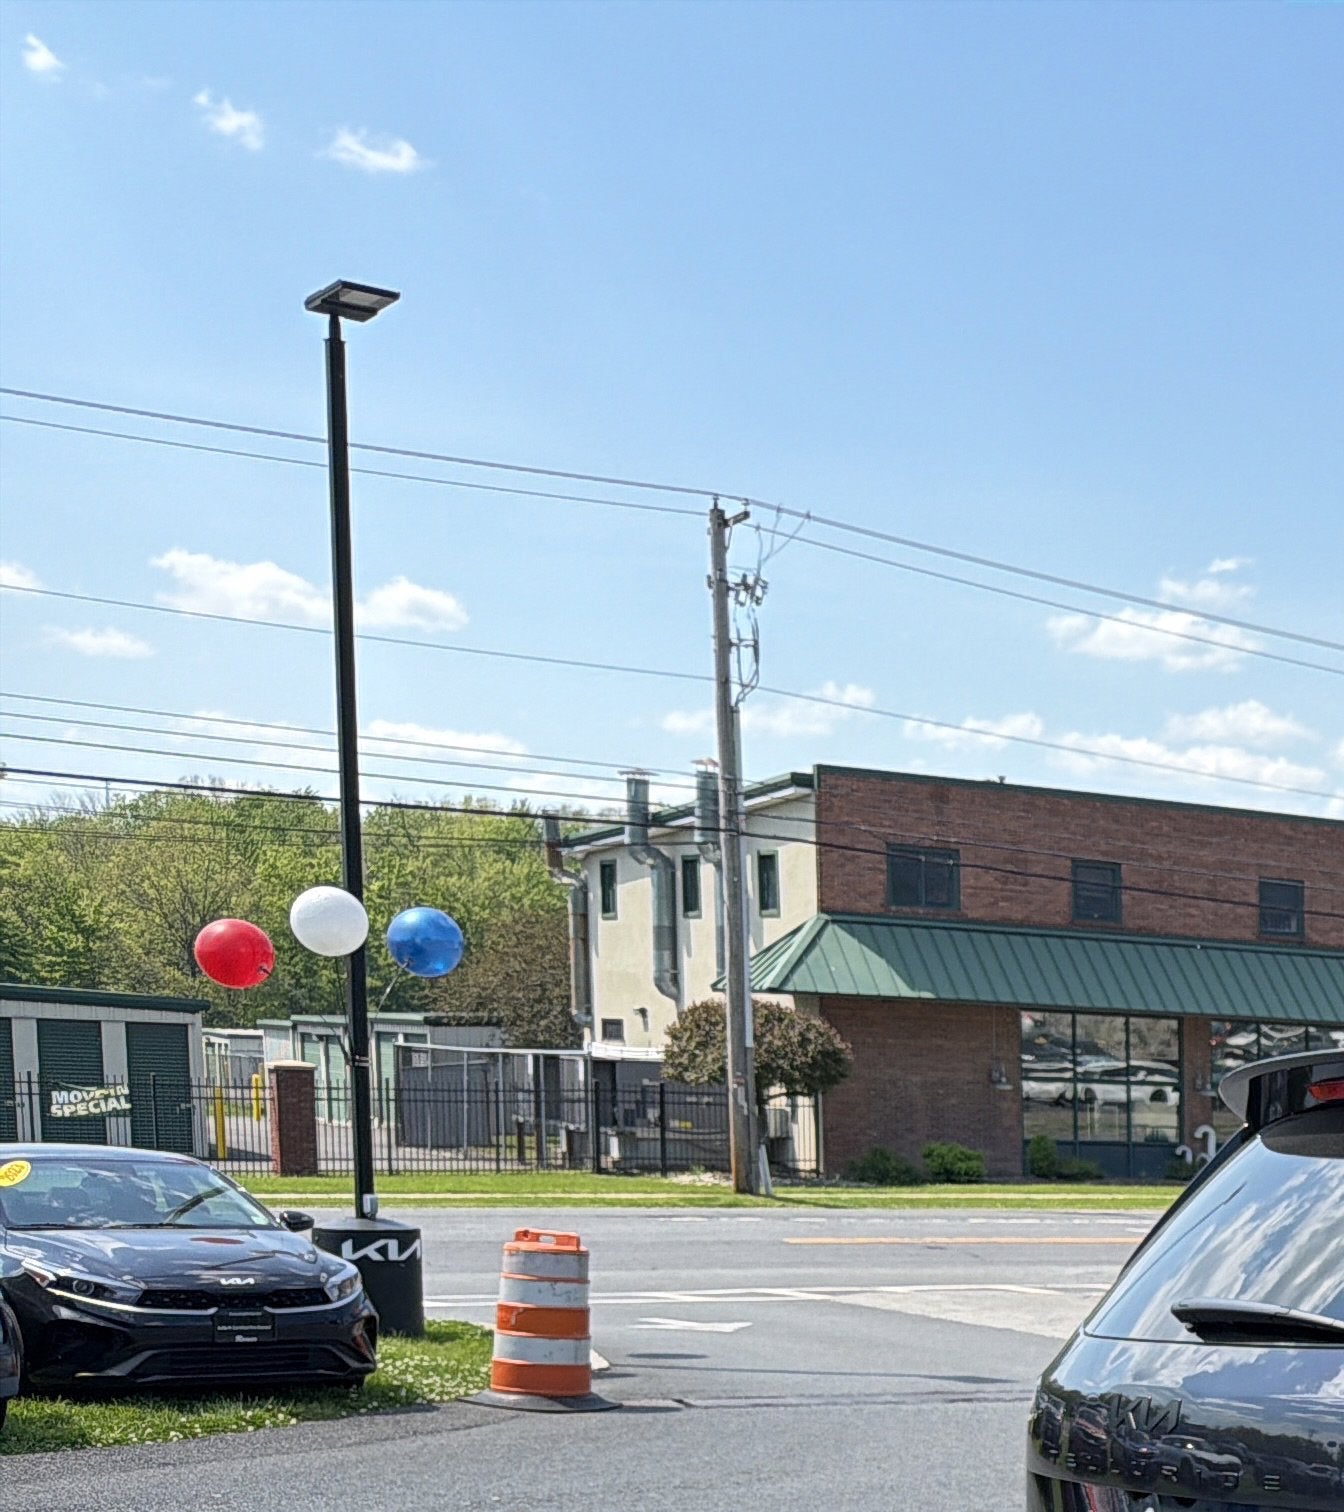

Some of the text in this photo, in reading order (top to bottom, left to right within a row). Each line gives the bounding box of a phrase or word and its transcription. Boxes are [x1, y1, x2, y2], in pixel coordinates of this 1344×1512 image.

[50, 1096, 132, 1117] SPECIAL
[341, 1238, 421, 1261] KIA
[220, 1277, 255, 1286] KIA
[1111, 1393, 1183, 1434] KIA
